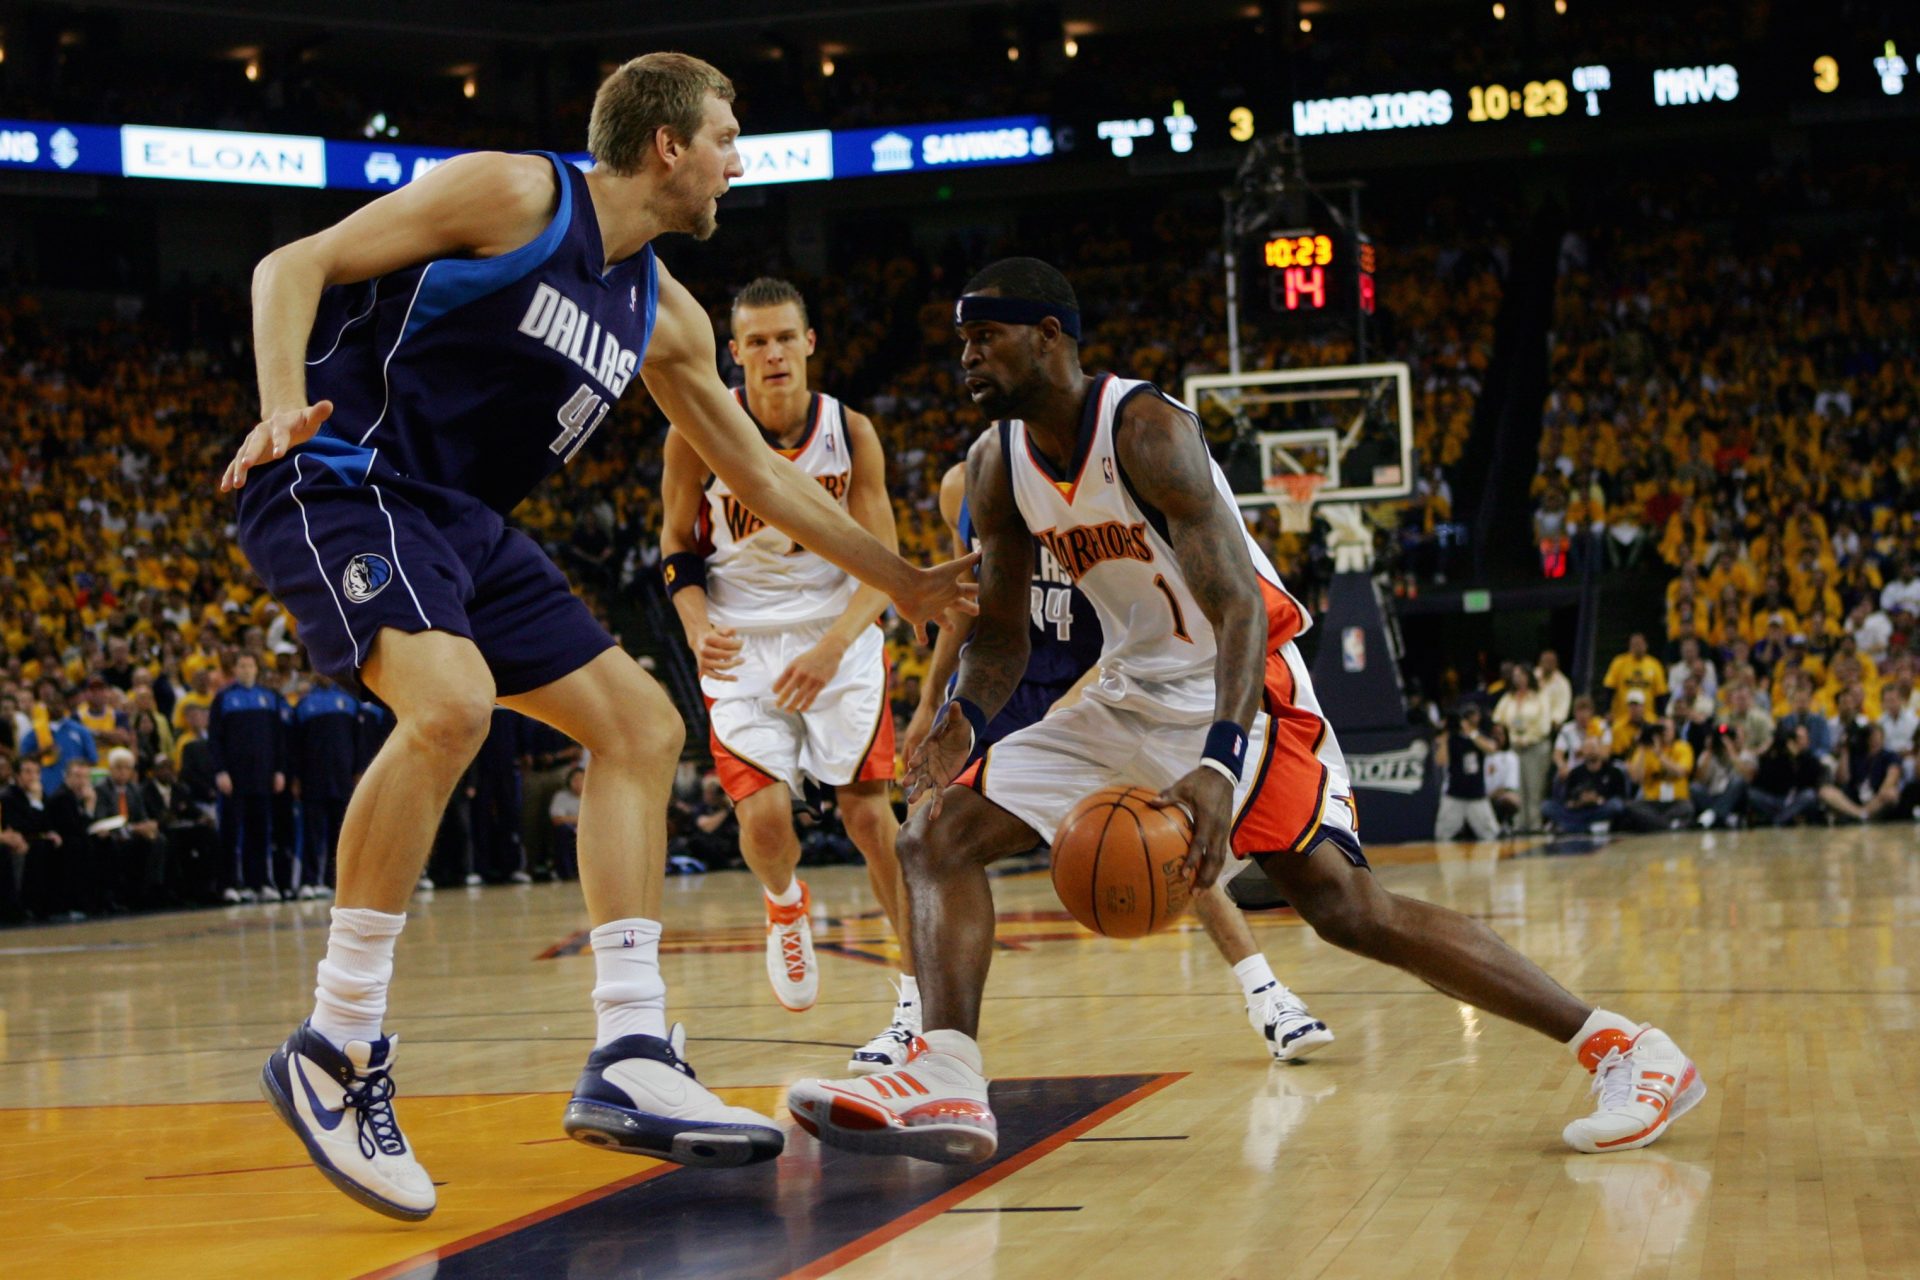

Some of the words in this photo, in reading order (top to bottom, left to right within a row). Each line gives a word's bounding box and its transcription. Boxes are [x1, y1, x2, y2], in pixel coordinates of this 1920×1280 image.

[1653, 64, 1740, 106] MAVS
[1813, 55, 1840, 93] 3
[1293, 89, 1453, 136] WARRIORS
[1467, 79, 1568, 122] 10:23
[1229, 106, 1254, 142] 3
[143, 141, 304, 174] E-LOAN
[1265, 235, 1332, 268] 10:23
[1285, 266, 1325, 310] 14
[517, 282, 638, 399] DALLAS
[549, 383, 610, 464] 41
[1153, 573, 1194, 645] 1
